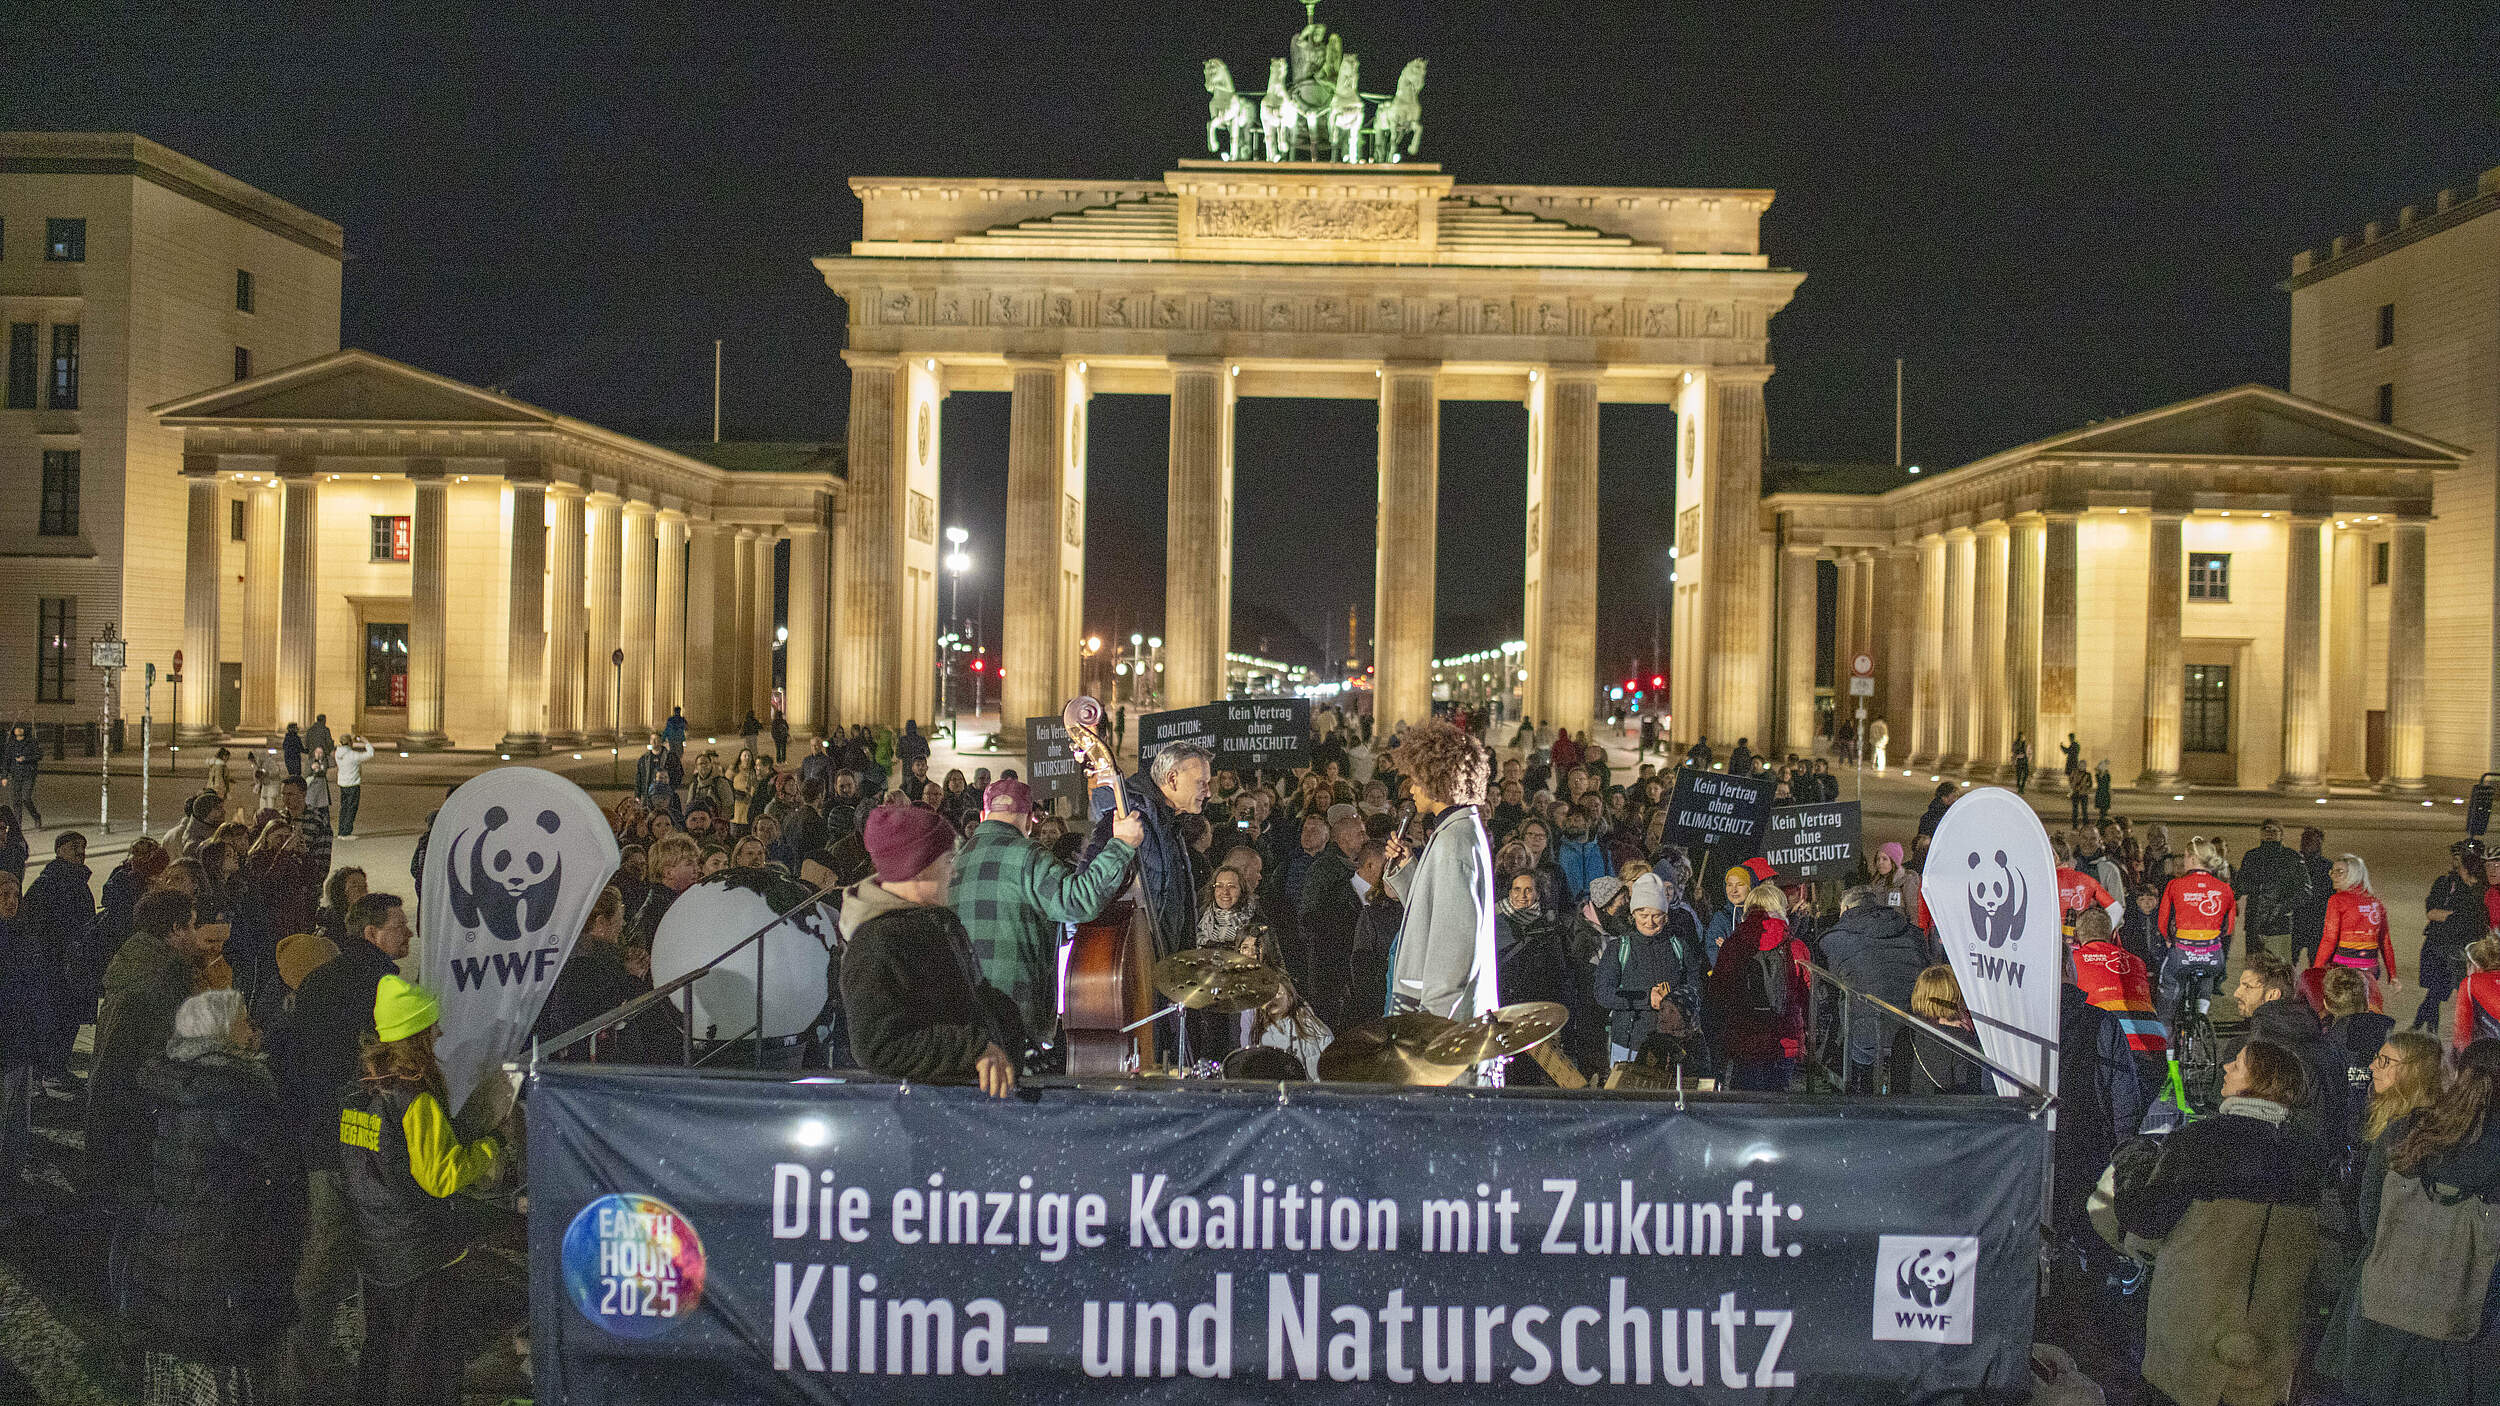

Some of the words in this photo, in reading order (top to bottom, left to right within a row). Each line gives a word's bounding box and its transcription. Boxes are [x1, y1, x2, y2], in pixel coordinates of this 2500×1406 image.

[1228, 706, 1250, 721] Kein
[1253, 705, 1292, 721] Vertrag
[1036, 724, 1050, 741] Kein
[1157, 719, 1201, 740] KOALITION:
[1247, 721, 1273, 735] ohne
[1047, 741, 1062, 757] ohne
[1223, 735, 1298, 752] KLIMASCHUTZ
[1033, 759, 1075, 778] NATURSCHUTZ
[1693, 777, 1717, 795] Kein
[1719, 781, 1758, 804] Vertrag
[1708, 797, 1734, 814] ohne
[1678, 810, 1754, 836] KLIMASCHUTZ
[1772, 815, 1796, 831] Kein
[1799, 812, 1842, 828] Vertrag
[1794, 829, 1821, 846] ohne
[1767, 842, 1851, 866] NATURSCHUTZ
[451, 947, 560, 993] WWF
[773, 1162, 870, 1242] Die
[892, 1173, 1107, 1262] einzige
[1130, 1173, 1398, 1251] Koalition
[1422, 1183, 1520, 1254] mit
[1541, 1179, 1804, 1258] Zukunft:
[598, 1208, 673, 1243] EARTH
[600, 1240, 676, 1279] HOUR
[600, 1278, 678, 1318] 2025
[773, 1263, 1050, 1376] Klima-
[1082, 1273, 1233, 1378] und
[1267, 1273, 1795, 1389] Naturschutz
[1894, 1311, 1953, 1331] WWF
